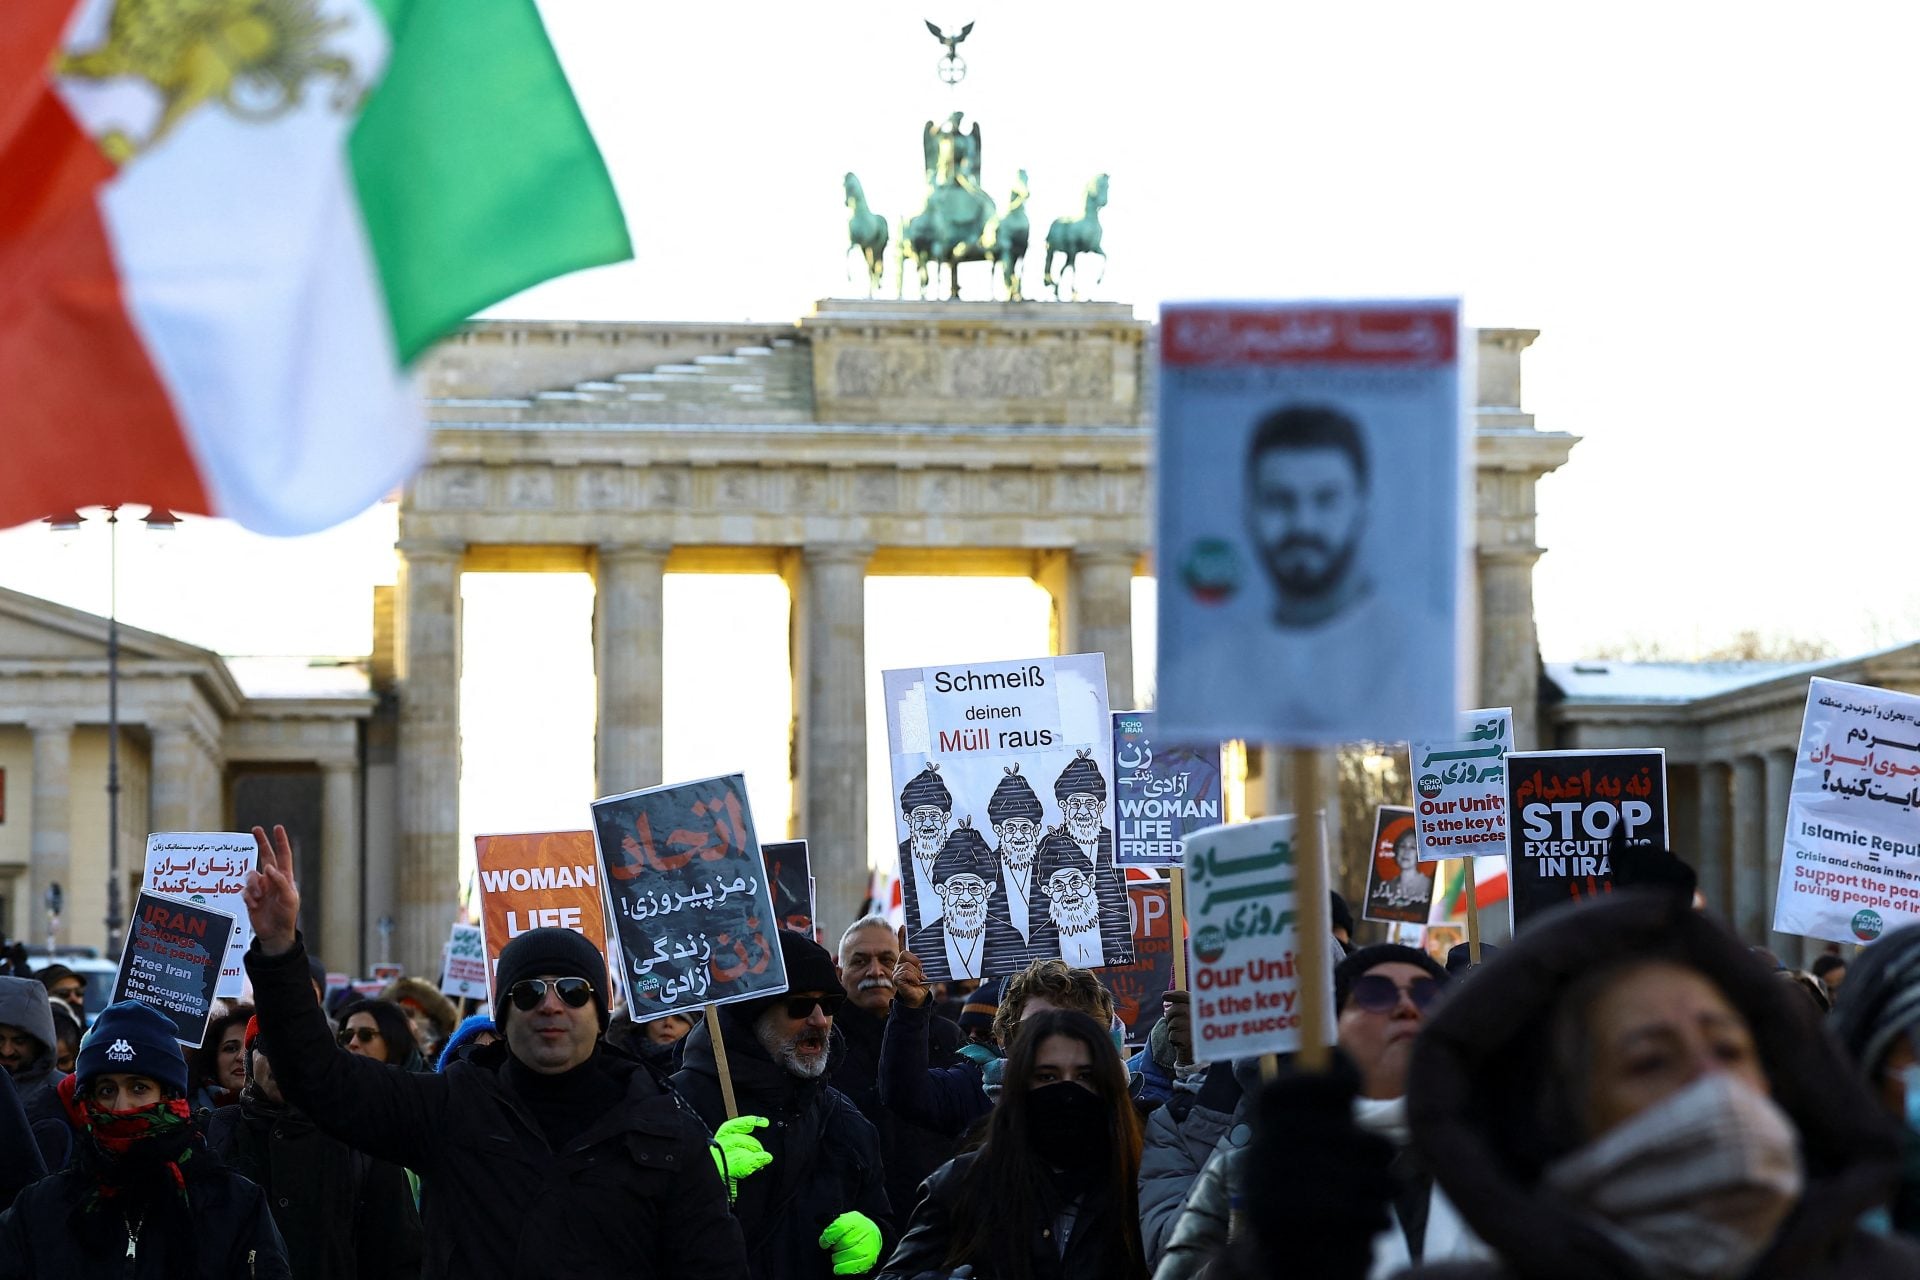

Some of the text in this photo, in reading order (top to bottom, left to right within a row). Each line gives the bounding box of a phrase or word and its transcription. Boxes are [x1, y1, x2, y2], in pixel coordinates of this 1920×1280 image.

[935, 665, 1045, 693] Schmeiß
[965, 704, 1021, 720] deinen
[939, 728, 1053, 753] Müll raus
[1117, 739, 1153, 769] زن
[1810, 743, 1874, 771] ایران
[1143, 771, 1191, 798] آزادی
[1424, 784, 1443, 792] IRAN
[1516, 768, 1592, 809] اعدام
[1118, 800, 1218, 818] WOMAN
[1419, 800, 1458, 816] Our
[1522, 801, 1652, 841] STOP
[611, 788, 747, 881] اتحاد
[1119, 820, 1172, 839] LIFE
[1422, 815, 1506, 833] is the key t
[1801, 822, 1868, 846] Islamic
[1425, 835, 1452, 847] Our
[1524, 838, 1652, 857] EXECUTI
[153, 856, 249, 877] از زنان ایران
[1539, 857, 1566, 877] IN
[1796, 850, 1827, 863] Crisis
[1828, 856, 1849, 867] and
[1850, 861, 1881, 874] chaos
[1883, 866, 1894, 877] in
[1895, 869, 1912, 880] the
[481, 865, 596, 893] WOMAN
[1795, 865, 1920, 899] Support the pea
[621, 883, 714, 921] پیروزی!
[1793, 880, 1840, 902] loving
[1842, 890, 1891, 908] people
[1894, 900, 1908, 912] of
[144, 903, 208, 938] IRAN
[506, 907, 584, 939] LIFE
[139, 923, 197, 949] belongs
[711, 916, 770, 983] زن
[132, 954, 192, 980] Free Iran
[633, 932, 711, 975] زندگی
[130, 967, 156, 982] from
[638, 977, 658, 988] ECHO
[659, 960, 712, 1004] آزادی
[1196, 952, 1300, 991] Our Uni
[127, 978, 203, 1006] the occupying
[642, 981, 660, 992] IRAN
[124, 988, 204, 1017] Islamic regime.
[1199, 989, 1297, 1019] is the key
[1202, 1022, 1239, 1041] Our
[108, 1051, 133, 1062] Kappa
